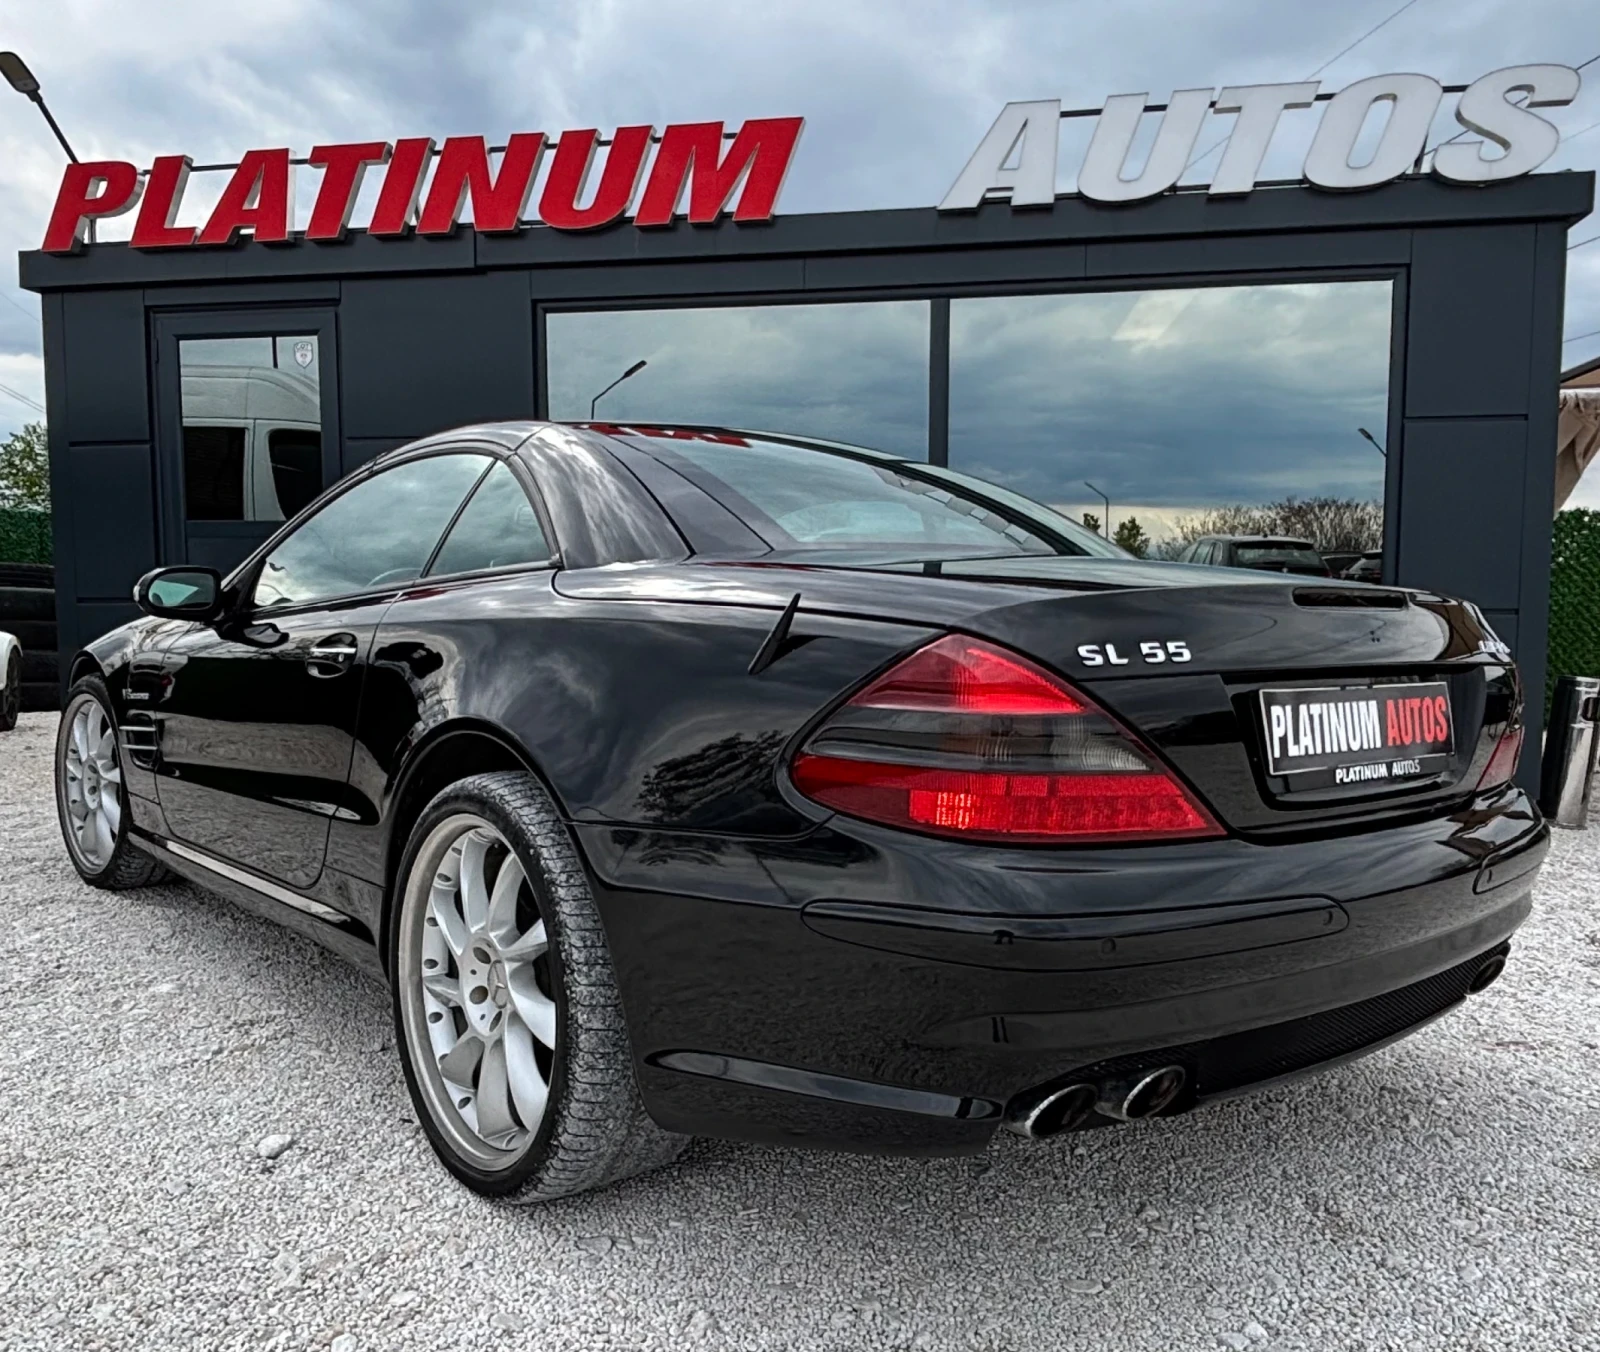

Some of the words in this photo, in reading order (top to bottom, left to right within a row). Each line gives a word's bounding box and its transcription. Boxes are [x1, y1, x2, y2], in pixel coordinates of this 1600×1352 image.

[42, 116, 805, 254] PLATINUM
[936, 64, 1582, 212] AUTOS
[1077, 643, 1129, 667] SL
[1139, 641, 1192, 664] 55
[1270, 700, 1382, 758] PLATINUM
[1386, 696, 1448, 746] AUTOS
[1335, 763, 1389, 784] PLATINUM
[1391, 759, 1421, 776] AUTOS
